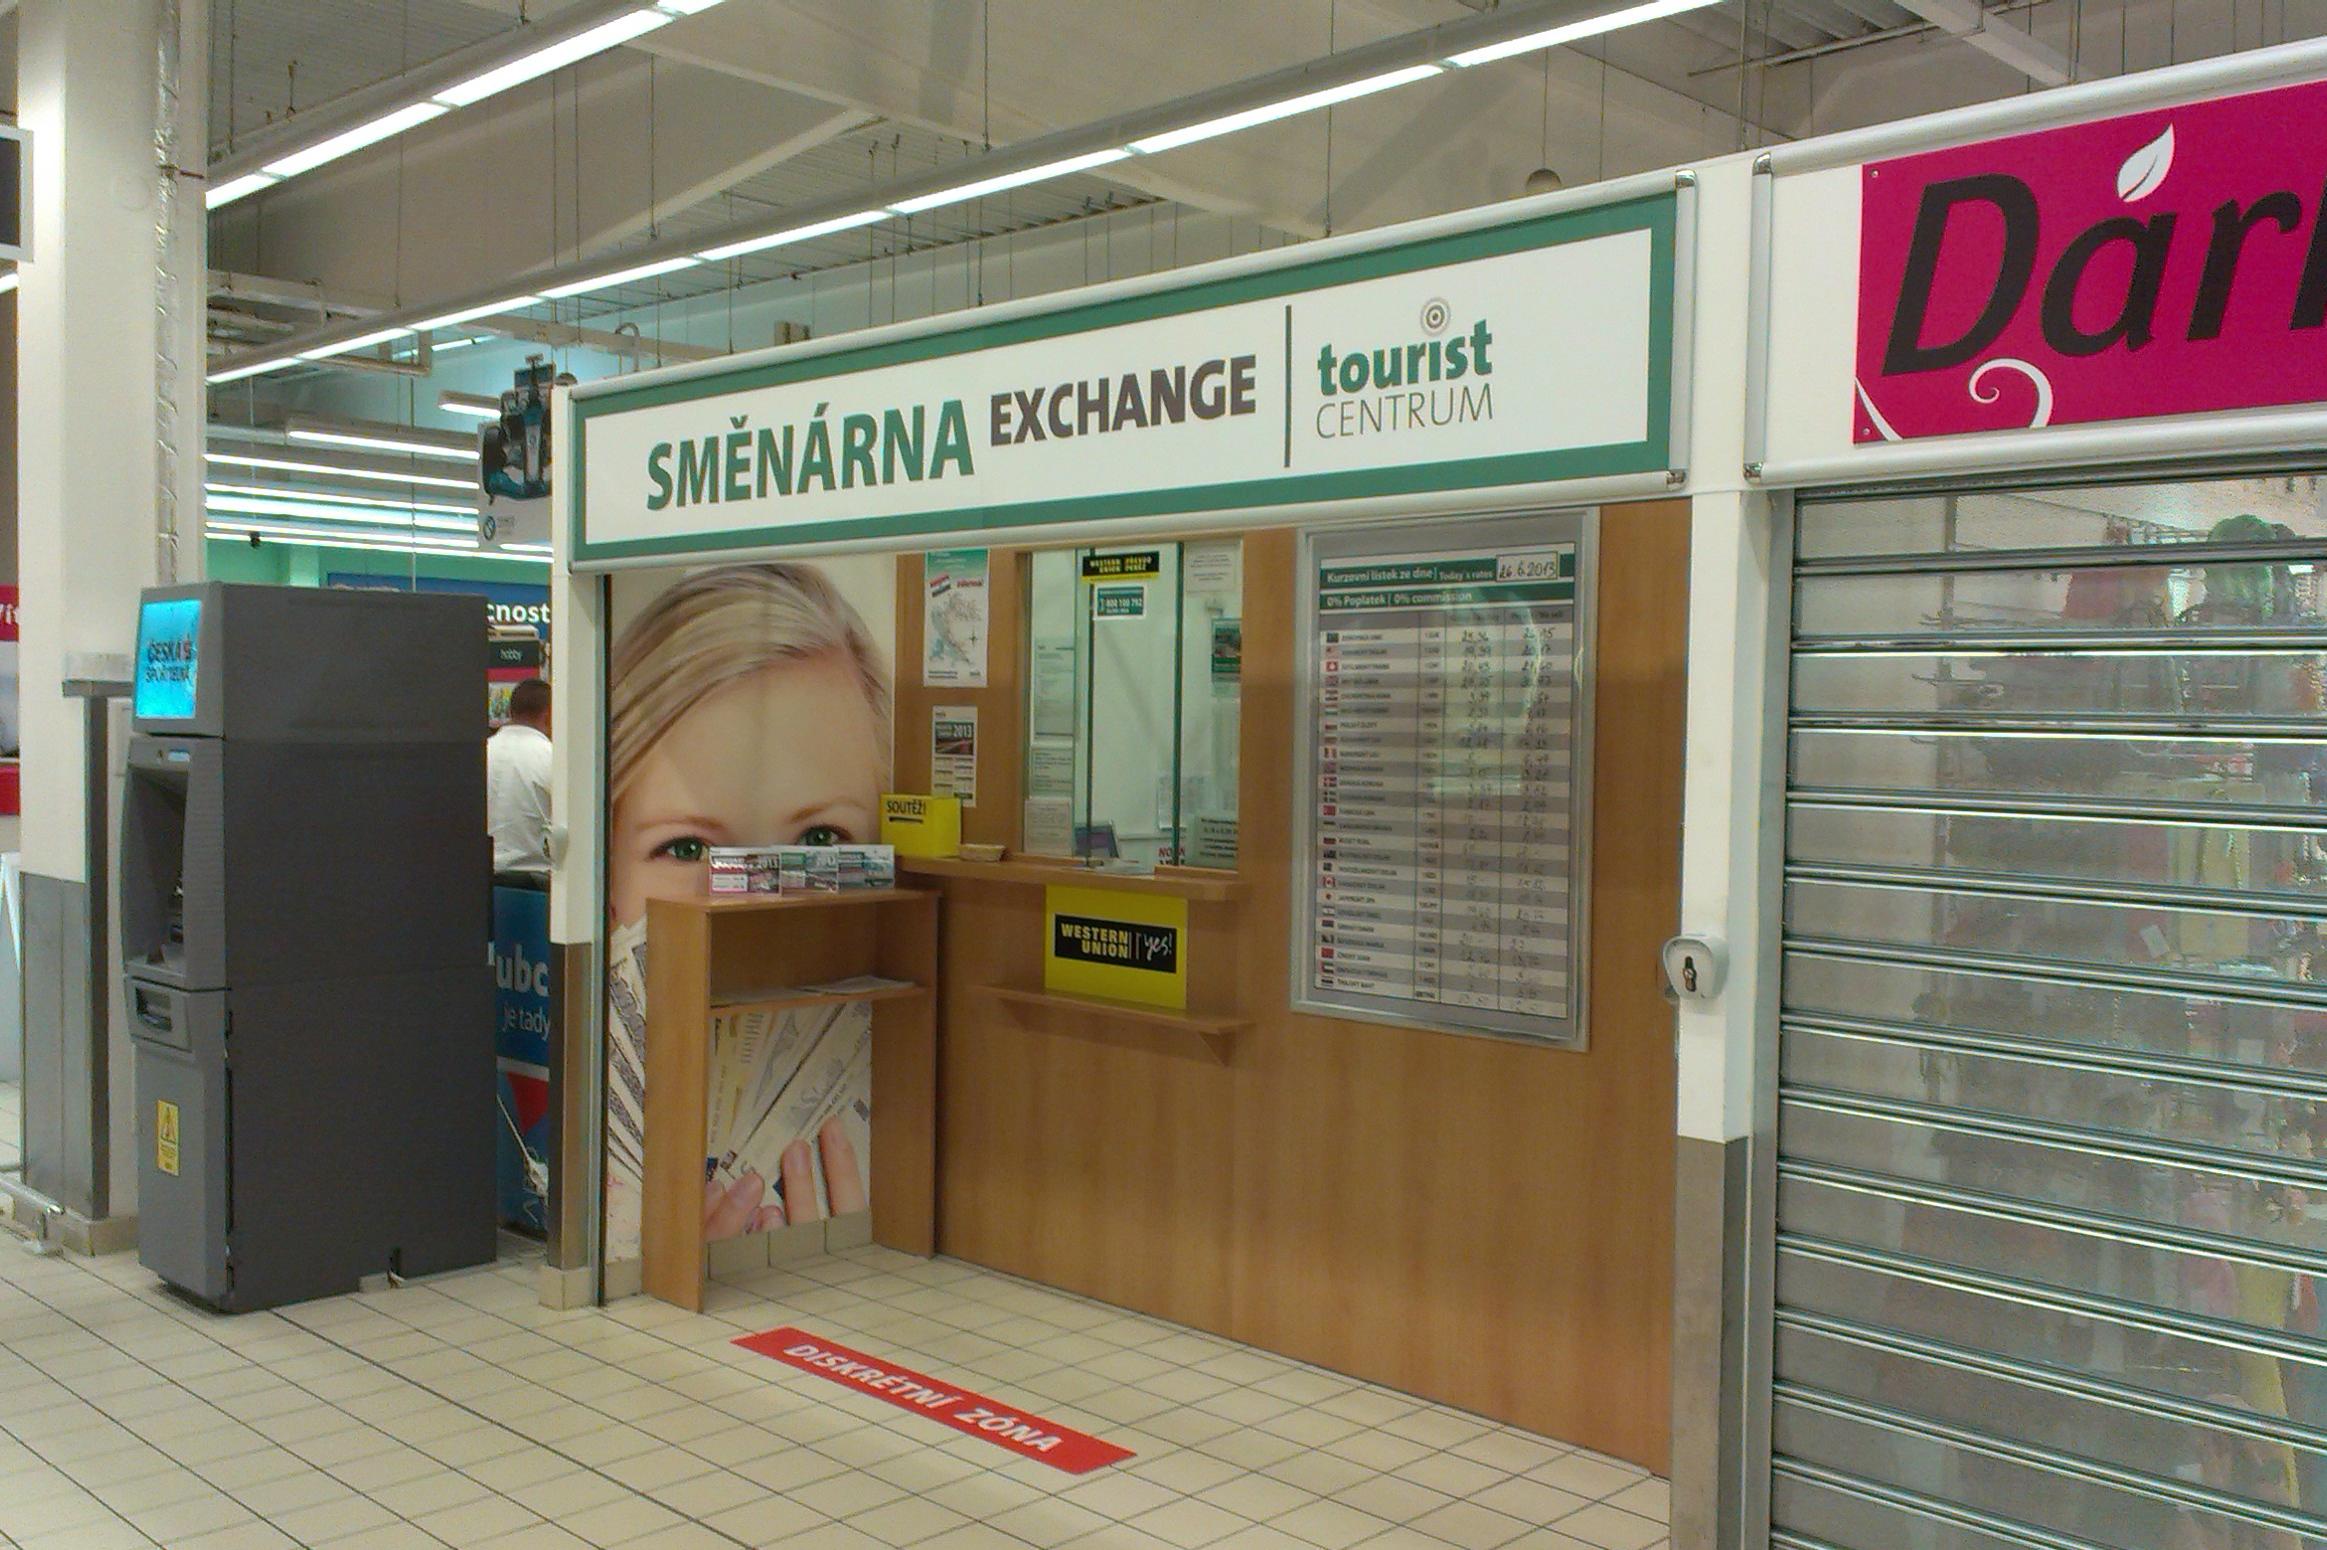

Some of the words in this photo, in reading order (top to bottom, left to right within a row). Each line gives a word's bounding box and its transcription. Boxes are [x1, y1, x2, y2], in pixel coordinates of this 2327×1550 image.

[1317, 310, 1493, 396] tourist
[647, 400, 975, 511] SMĚNÁRNA
[990, 354, 1256, 446] EXCHANGE
[1316, 383, 1493, 439] CENTRUM
[1061, 923, 1128, 944] WESTERN
[1081, 940, 1128, 959] UNION
[1143, 931, 1173, 961] yes!
[784, 1343, 966, 1409] DISKRÉTNÍ
[953, 1406, 1063, 1453] ZÓNA
